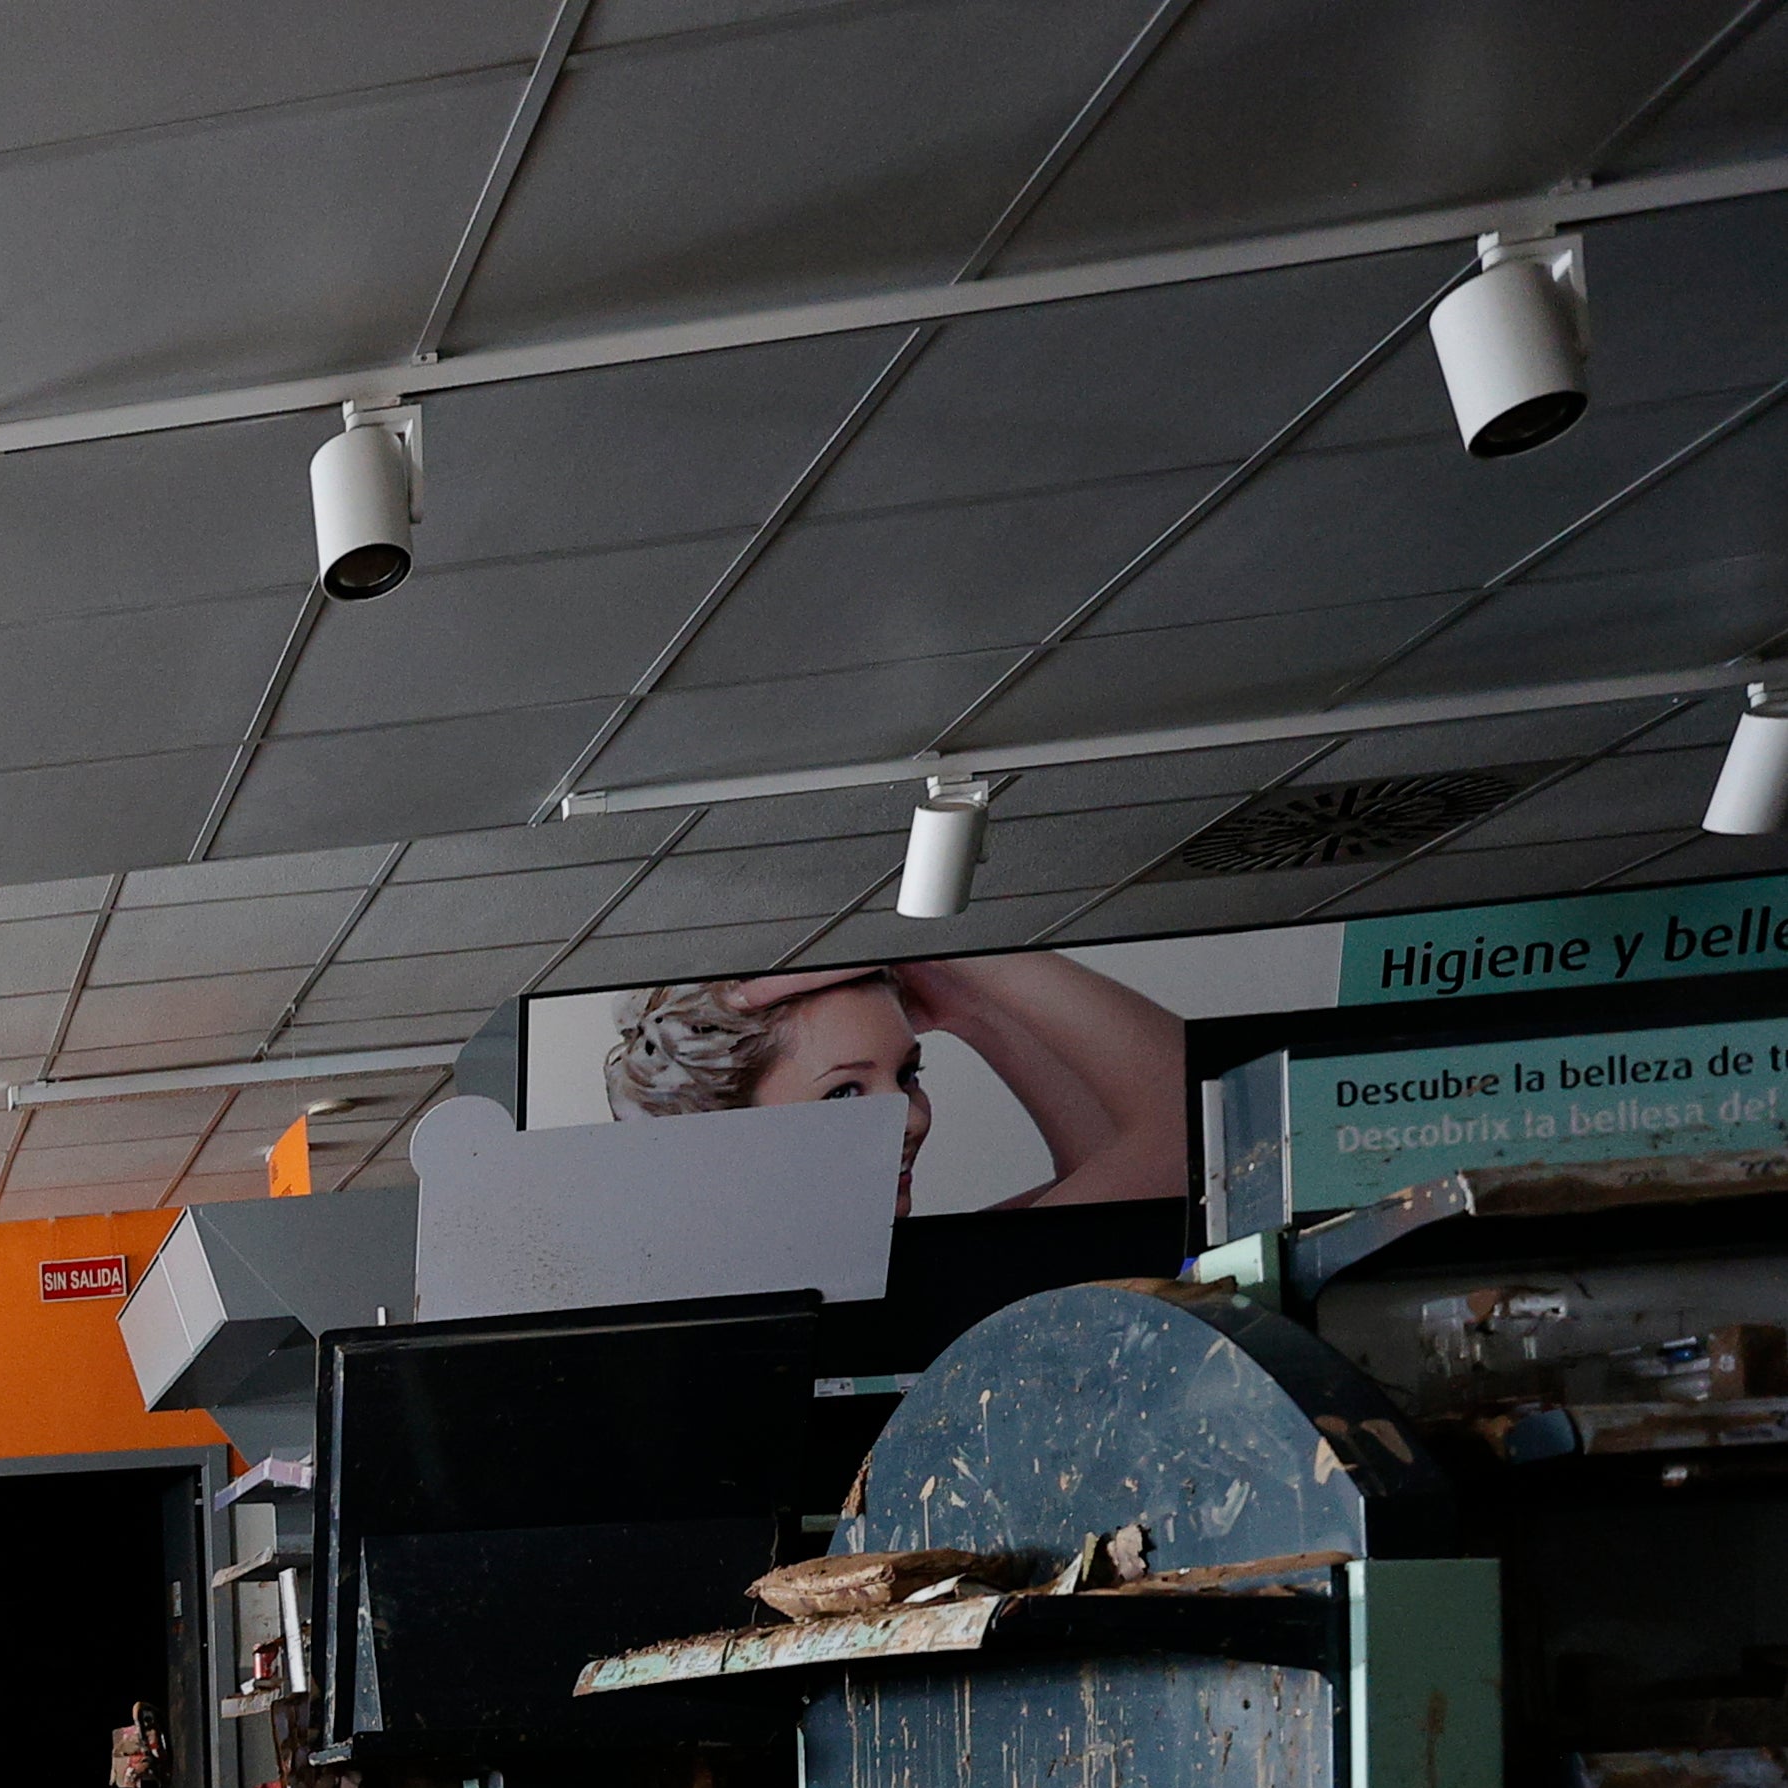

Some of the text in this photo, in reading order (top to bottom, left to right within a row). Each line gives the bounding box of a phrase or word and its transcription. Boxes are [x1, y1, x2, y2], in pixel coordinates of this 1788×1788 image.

[1380, 936, 1590, 996] Higiene
[1613, 932, 1644, 979] y
[1336, 1068, 1500, 1109] Descubre
[1514, 1062, 1545, 1093] la
[1559, 1053, 1693, 1090] belleza
[1707, 1044, 1754, 1077] de
[1337, 1112, 1511, 1154] Descobrix
[1524, 1110, 1557, 1139] la
[1569, 1097, 1704, 1135] bellesa
[44, 1267, 122, 1292] SIN SALIDA
